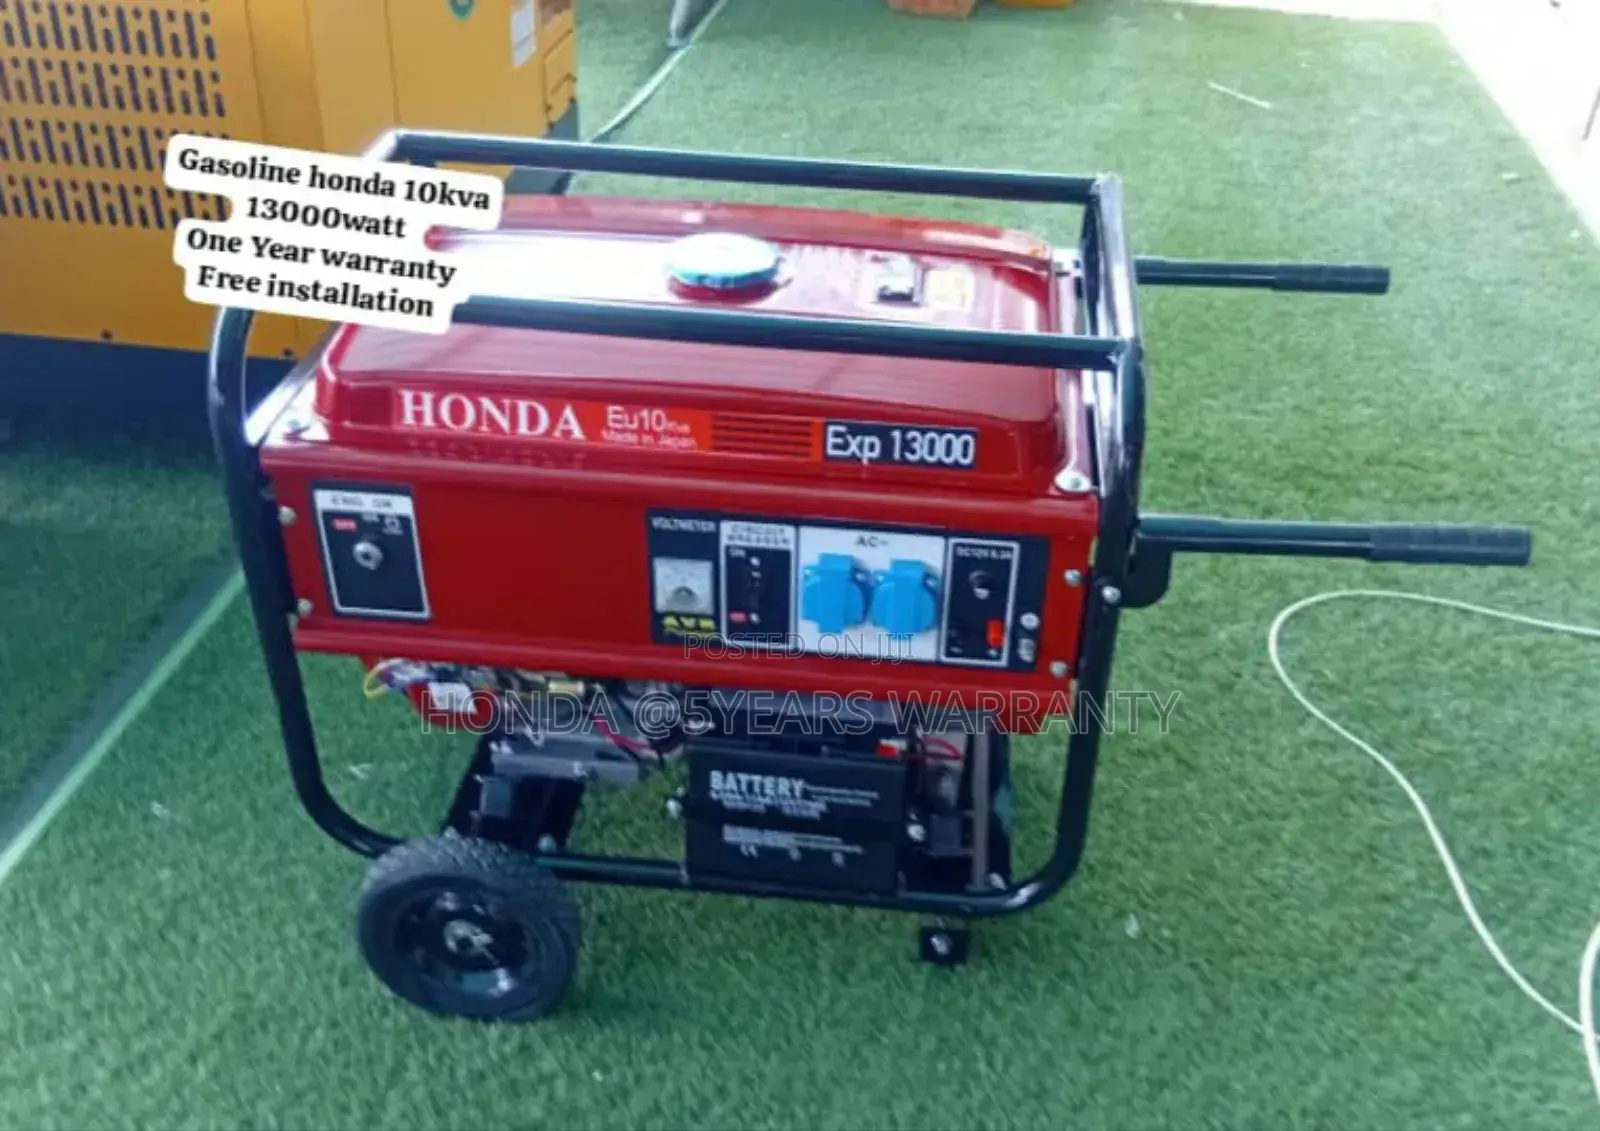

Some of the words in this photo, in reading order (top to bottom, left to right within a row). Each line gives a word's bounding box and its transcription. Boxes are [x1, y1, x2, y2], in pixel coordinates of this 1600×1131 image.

[400, 388, 586, 440] HONDA
[826, 424, 882, 465] Exp
[891, 430, 976, 465] 13000
[651, 516, 717, 533] VOLTMETER
[709, 769, 805, 799] BATTERY
